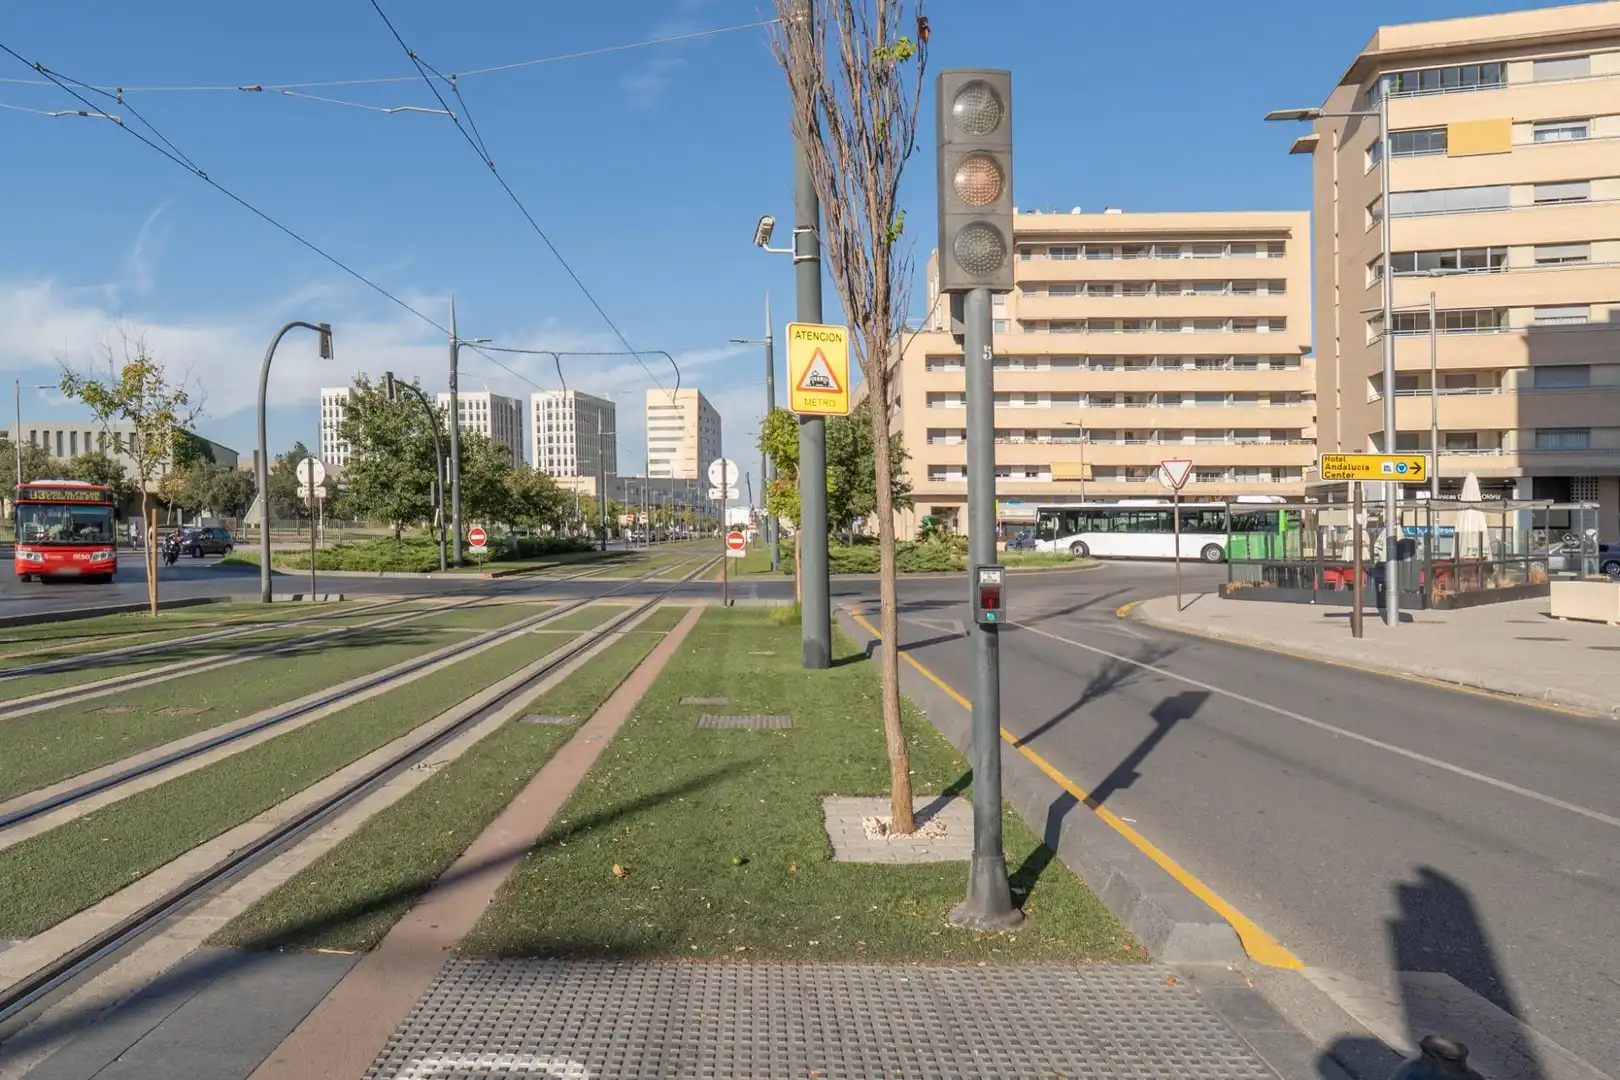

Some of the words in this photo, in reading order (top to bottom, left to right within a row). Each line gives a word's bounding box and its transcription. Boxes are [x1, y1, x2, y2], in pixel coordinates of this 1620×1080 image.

[795, 330, 842, 343] ATENCION
[804, 398, 836, 408] METRO
[1324, 455, 1346, 463] Hotel
[1324, 471, 1355, 479] Center
